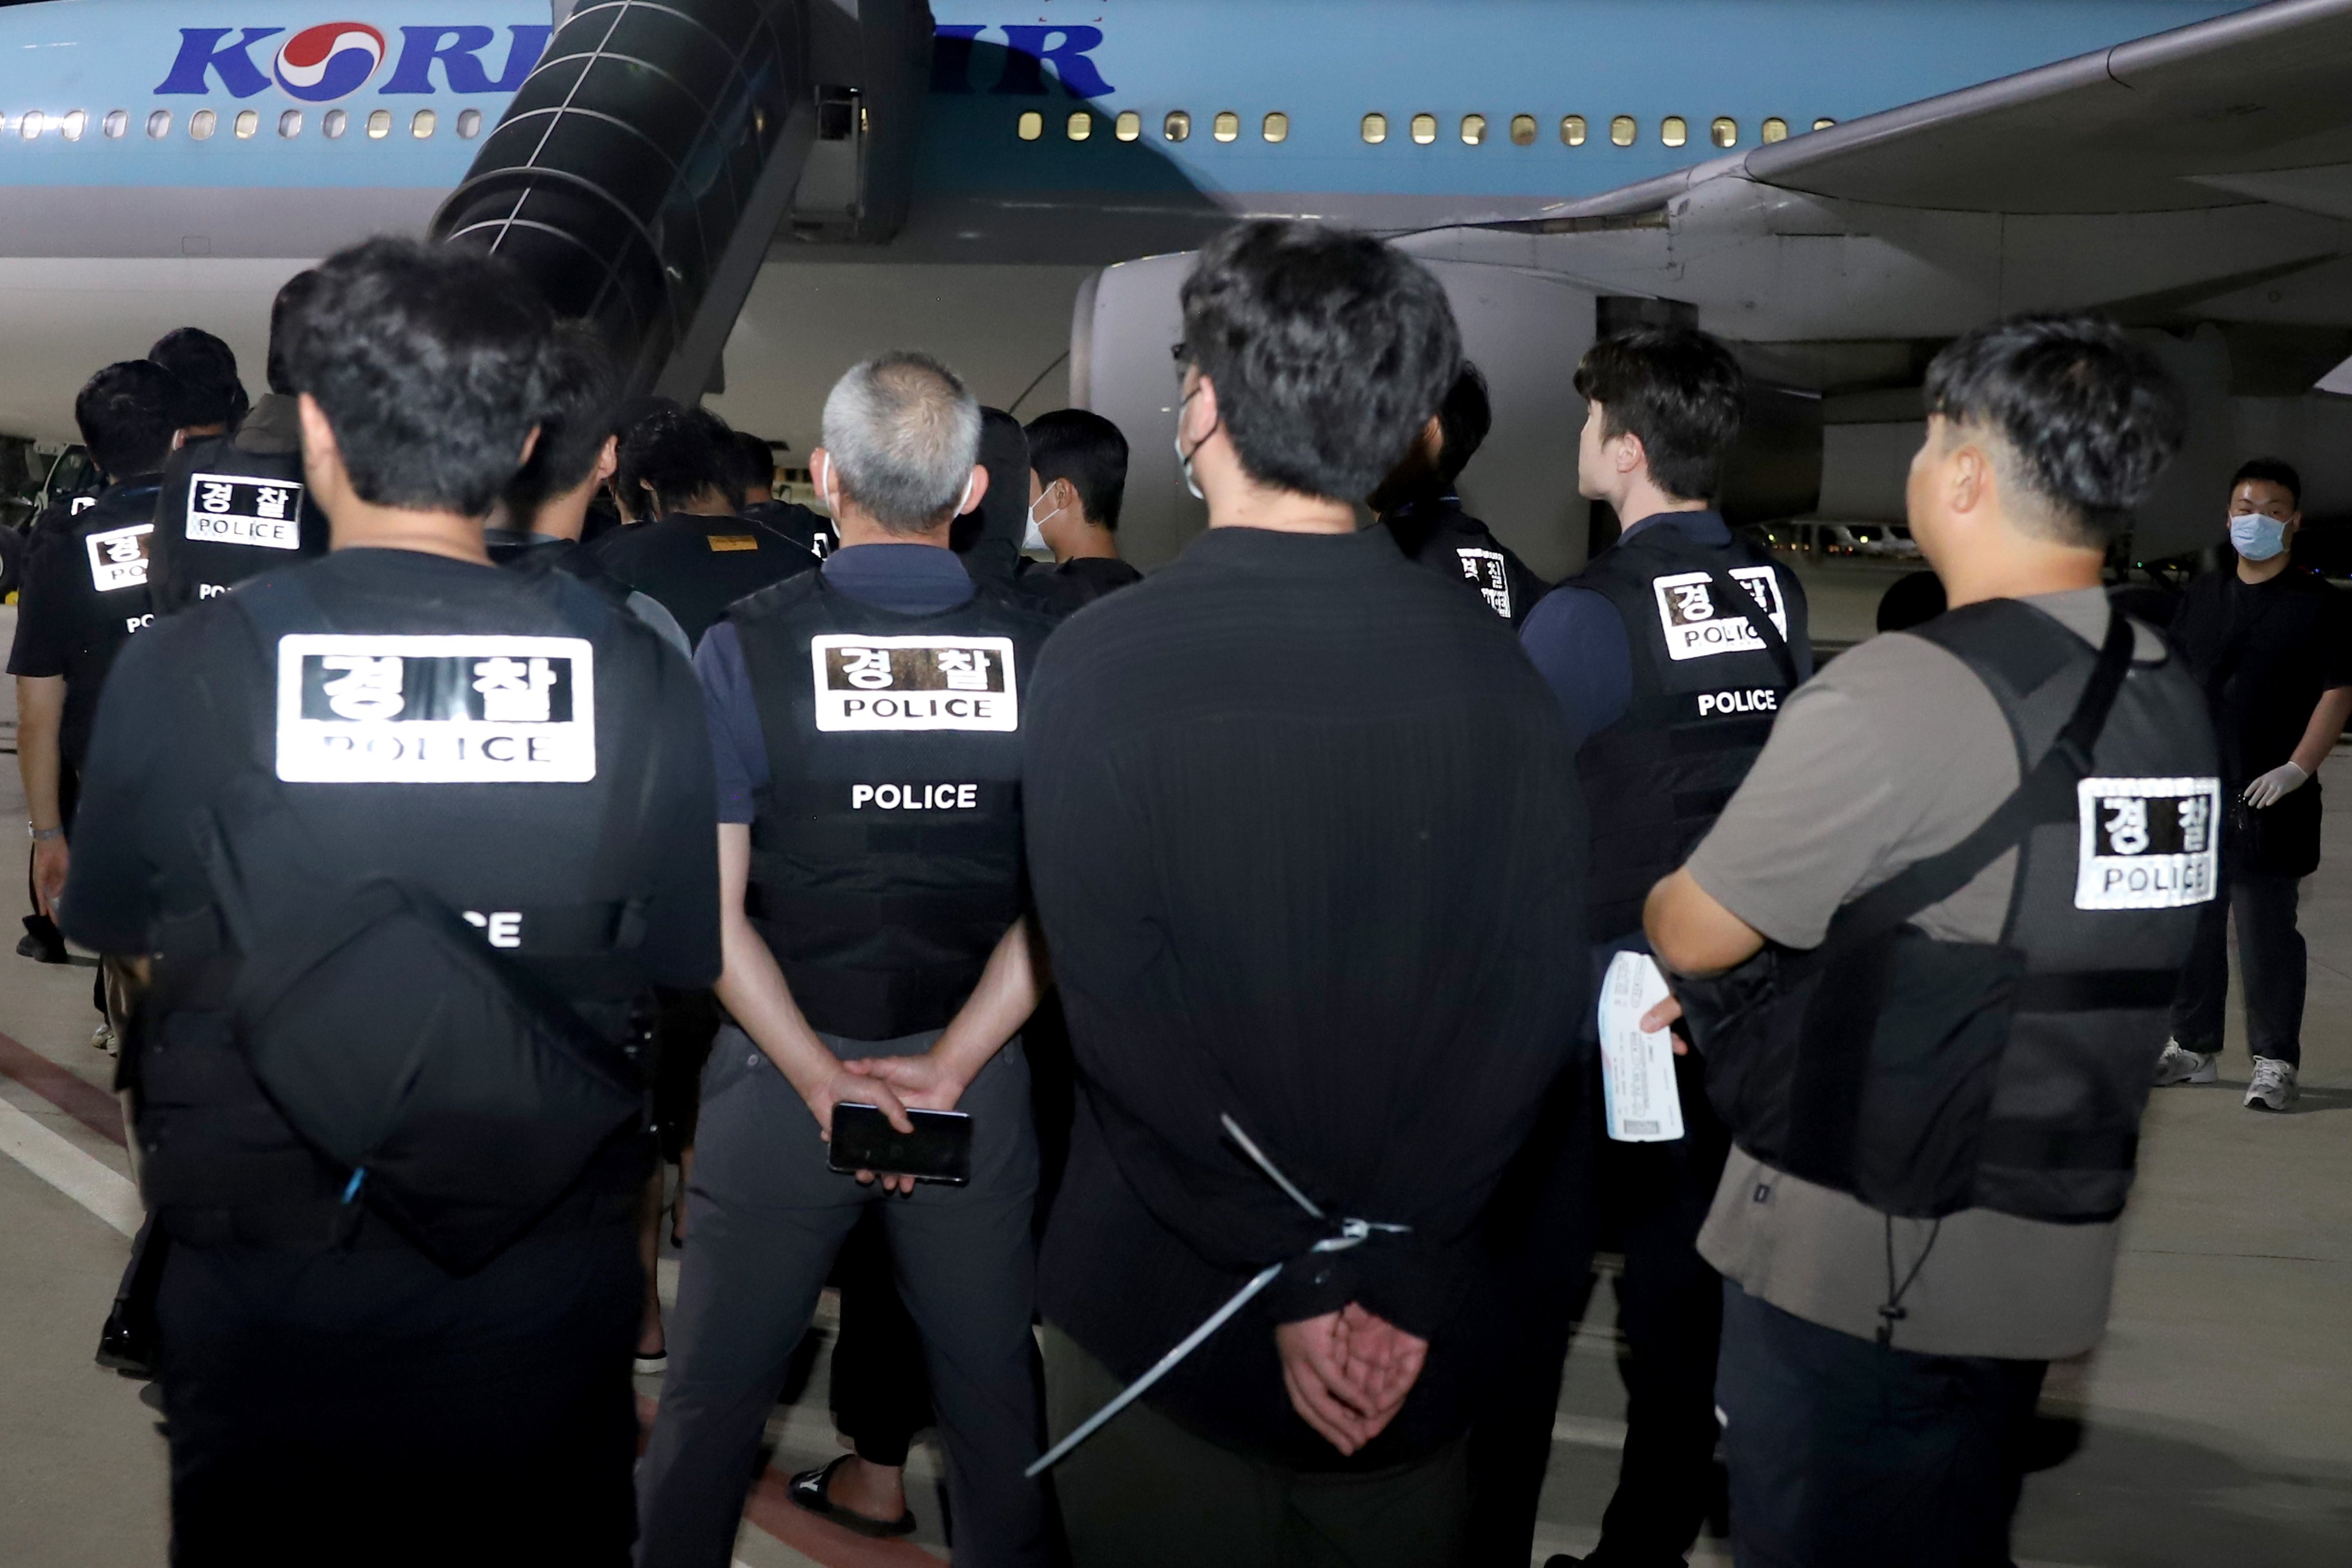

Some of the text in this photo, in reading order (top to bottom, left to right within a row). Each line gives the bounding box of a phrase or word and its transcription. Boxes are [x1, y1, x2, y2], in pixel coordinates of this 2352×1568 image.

[928, 25, 1115, 98] IR
[202, 482, 289, 518] 경찰
[199, 519, 284, 539] POLICE
[105, 535, 141, 562] 경
[1685, 625, 1758, 647] POLIC
[840, 648, 991, 690] 경찰
[323, 656, 557, 721] 경찰
[1698, 689, 1777, 716] POLICE
[844, 698, 992, 717] POLICE
[852, 784, 978, 809] POLICE
[2103, 797, 2208, 853] 경찰
[2104, 863, 2203, 893] POLICE
